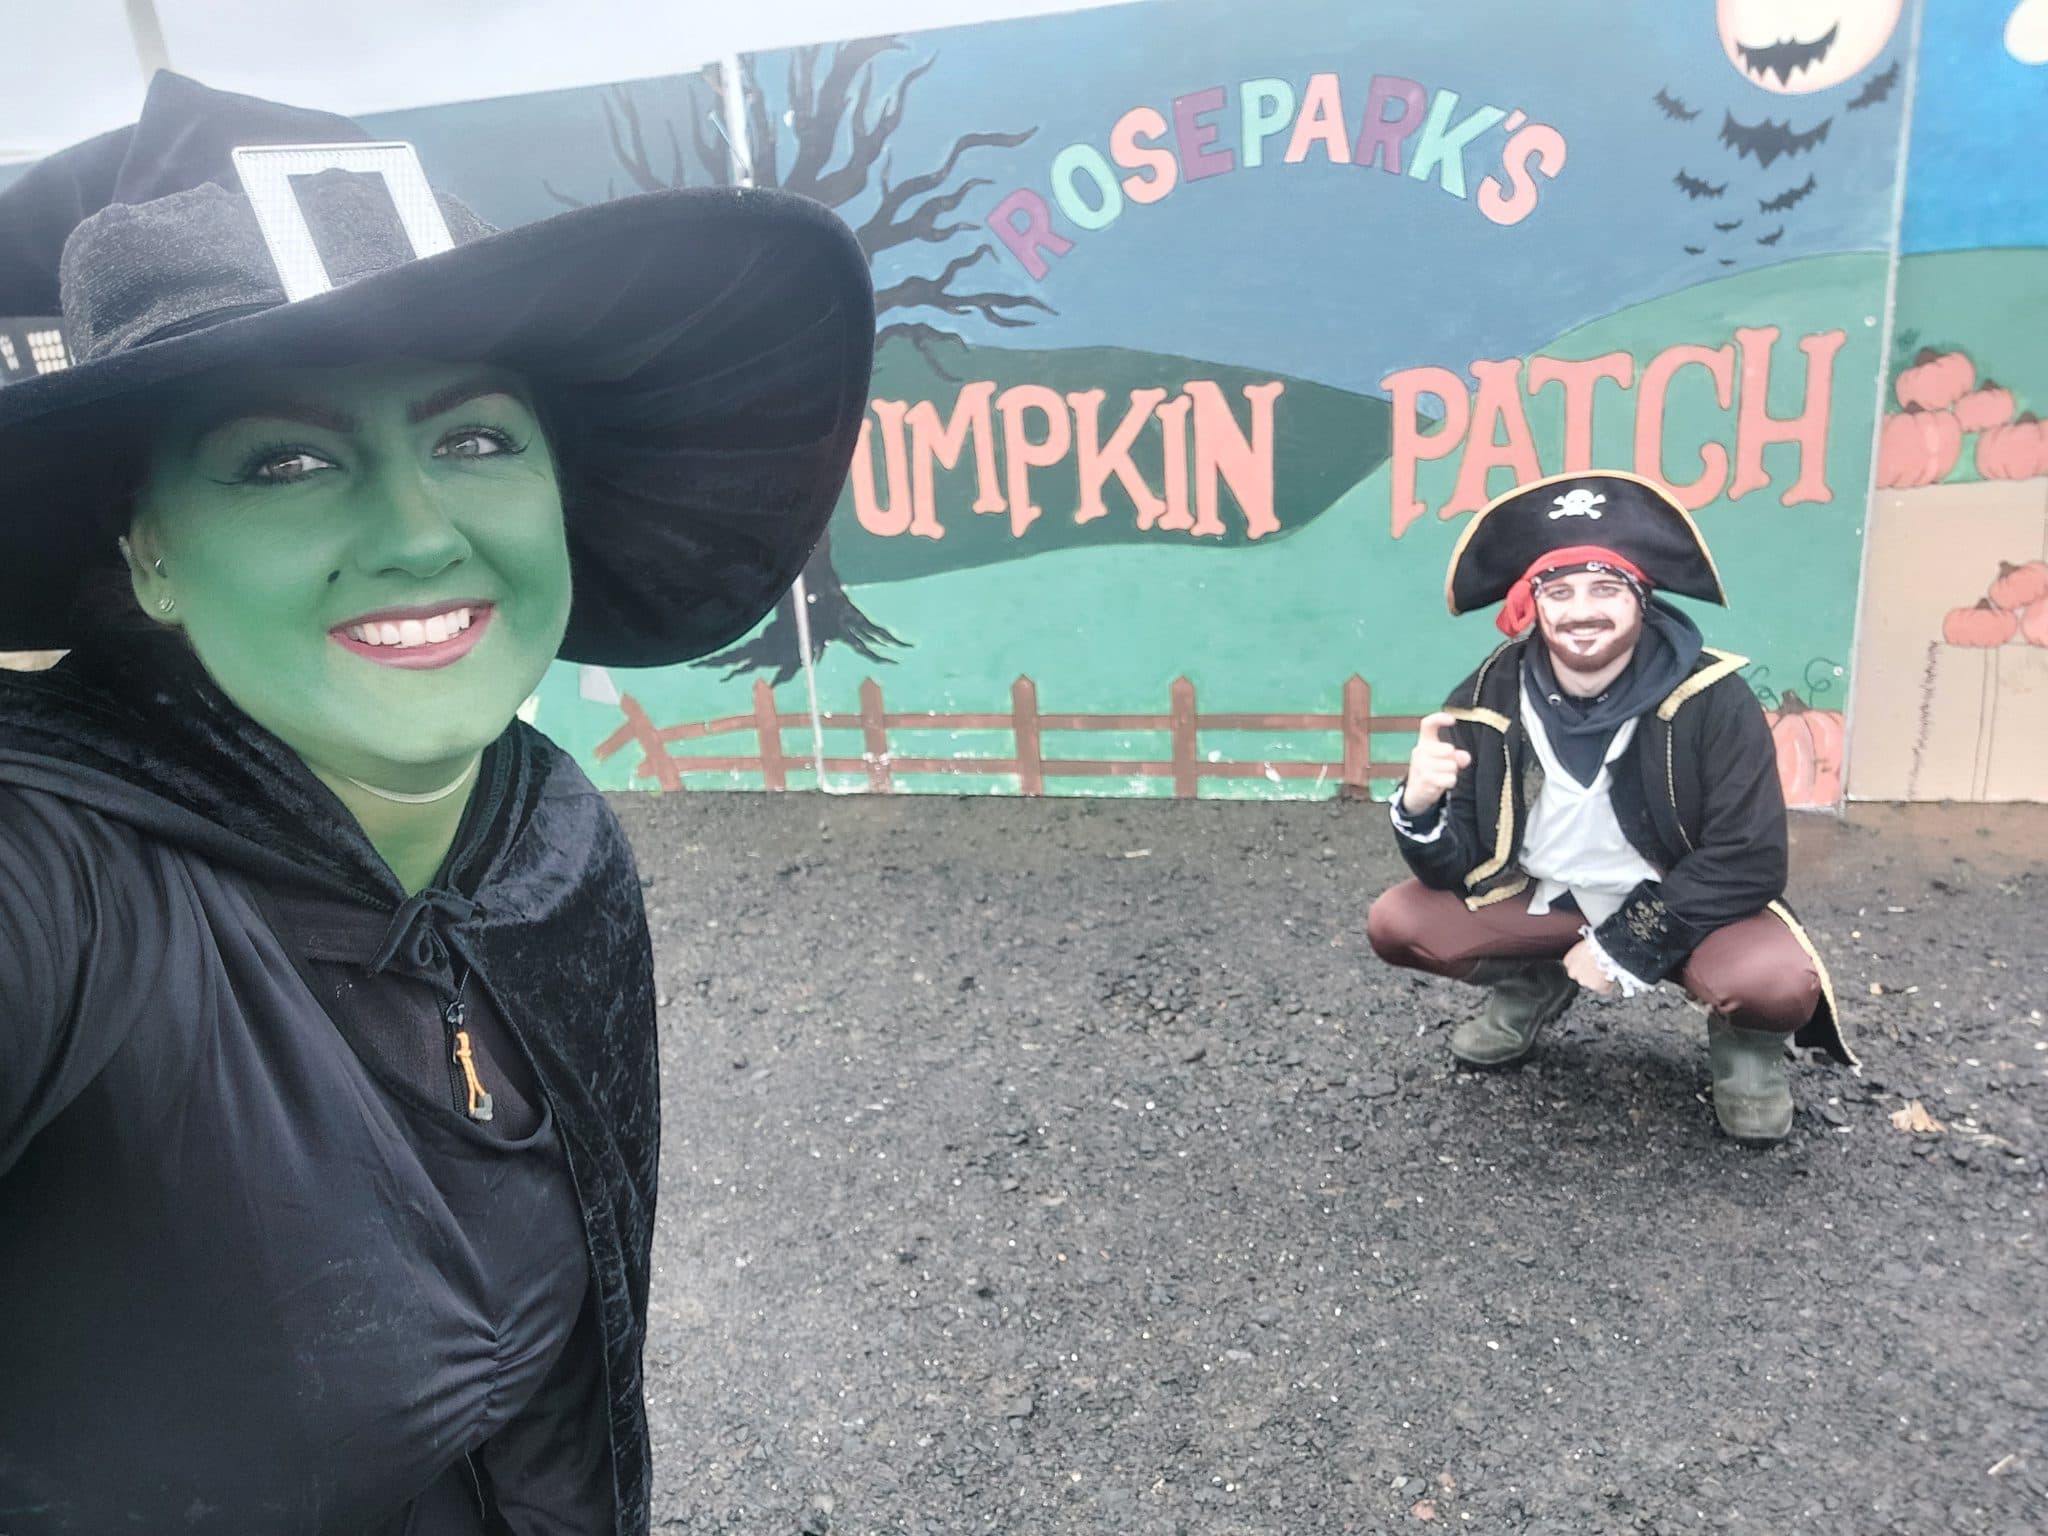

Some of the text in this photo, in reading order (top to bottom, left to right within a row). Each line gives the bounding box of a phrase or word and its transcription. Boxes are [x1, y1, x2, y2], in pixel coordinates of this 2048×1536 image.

[986, 72, 1567, 282] ROSEPARK'S
[852, 327, 1847, 541] UMPKIN PATCH
